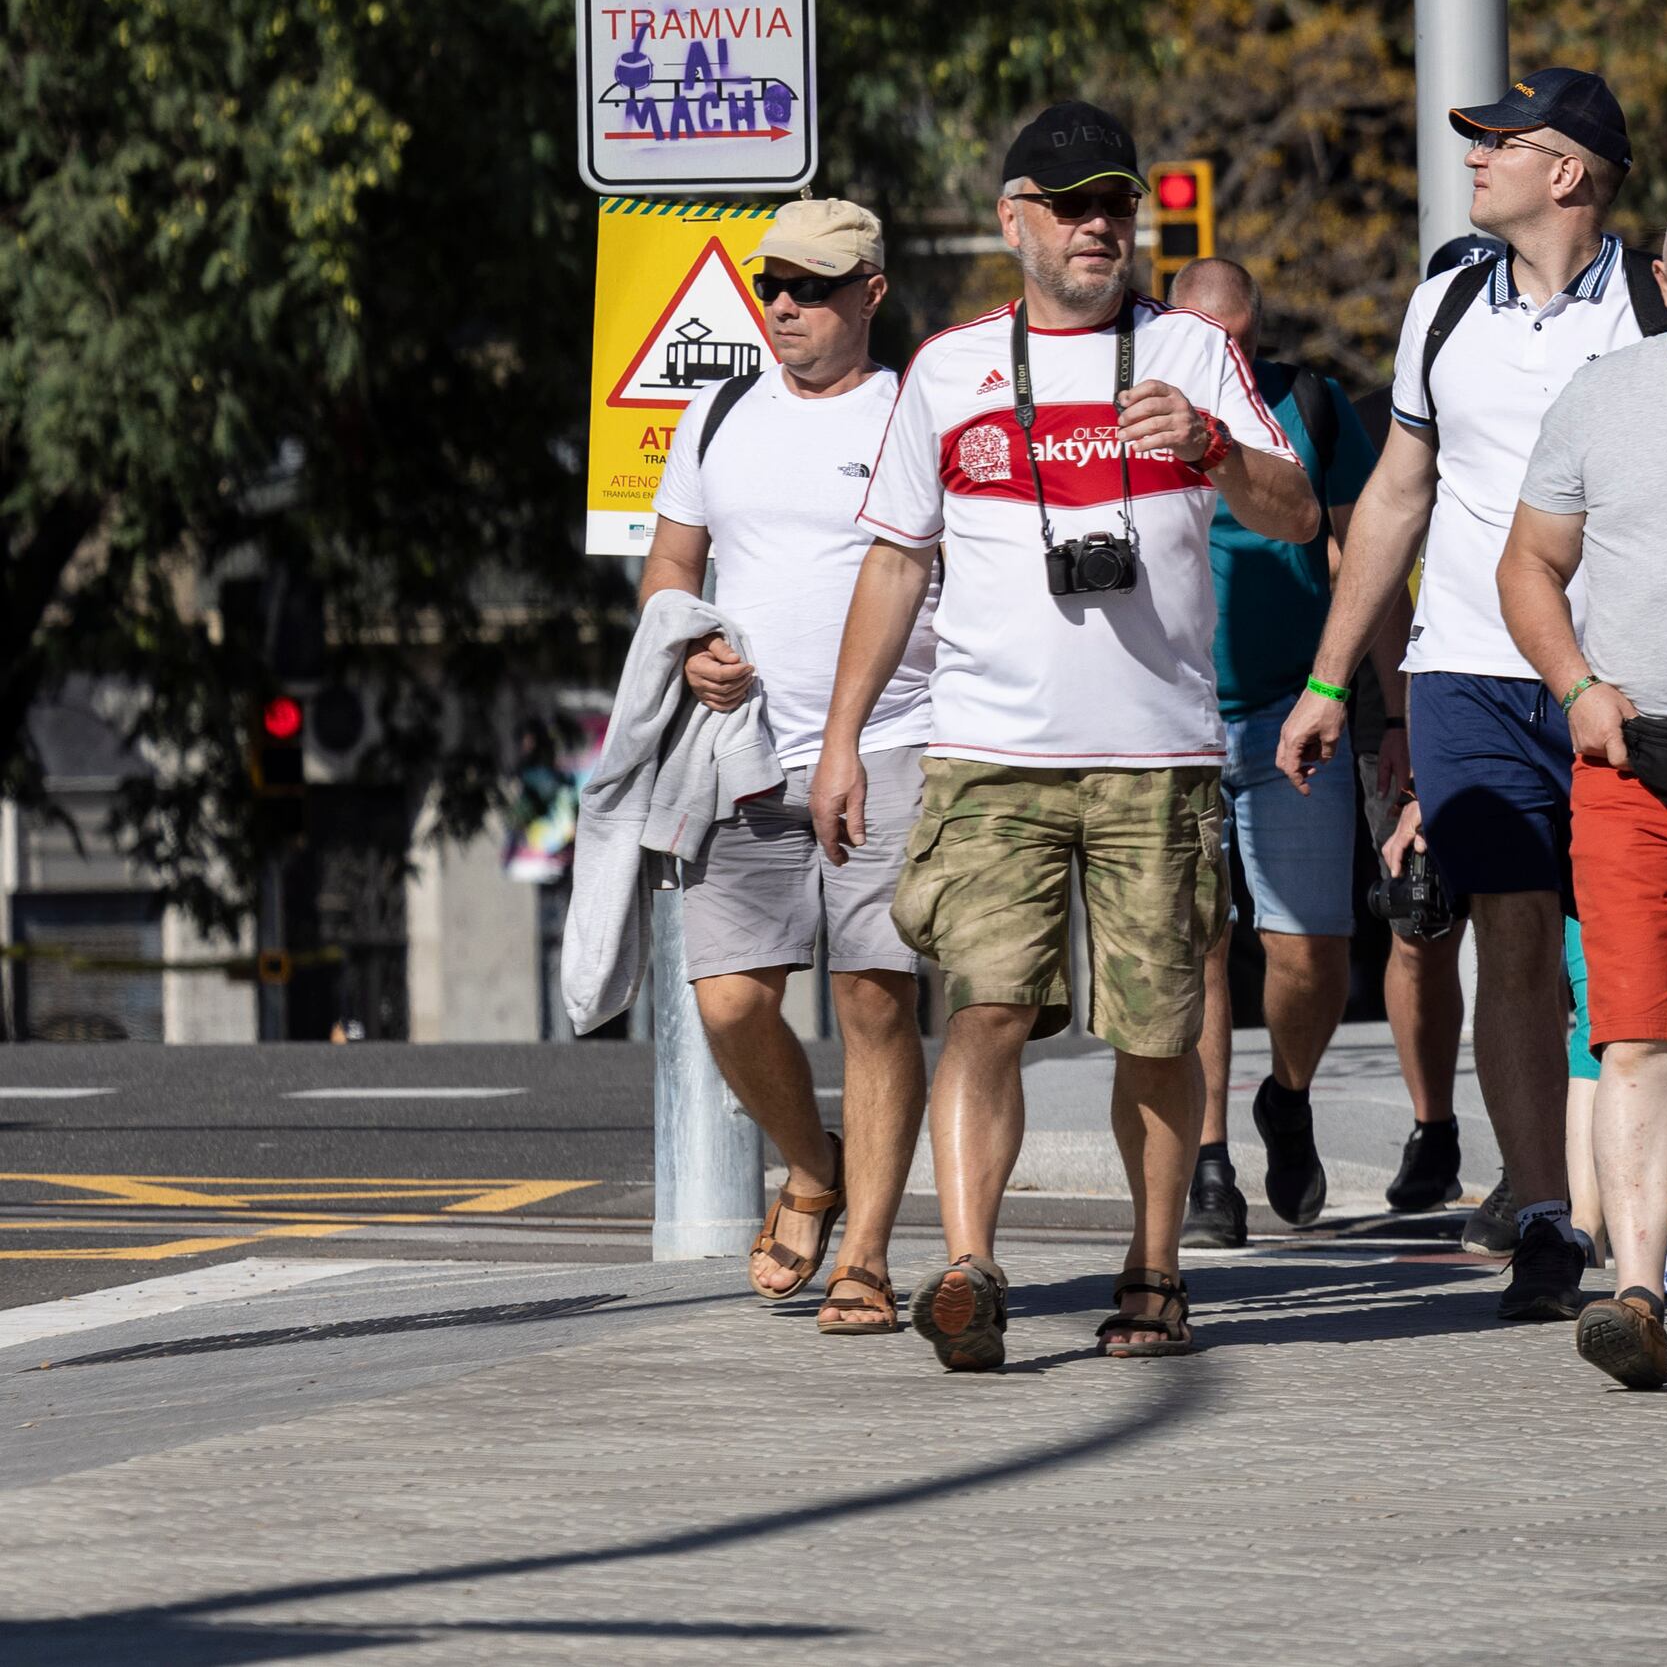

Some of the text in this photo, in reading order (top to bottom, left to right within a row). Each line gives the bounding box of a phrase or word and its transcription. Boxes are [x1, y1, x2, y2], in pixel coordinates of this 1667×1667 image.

[601, 7, 793, 40] TRAMVIA
[683, 38, 752, 91] AL
[1120, 335, 1131, 382] COOLPIX
[976, 380, 1010, 395] adidas
[1017, 364, 1028, 394] Nikon
